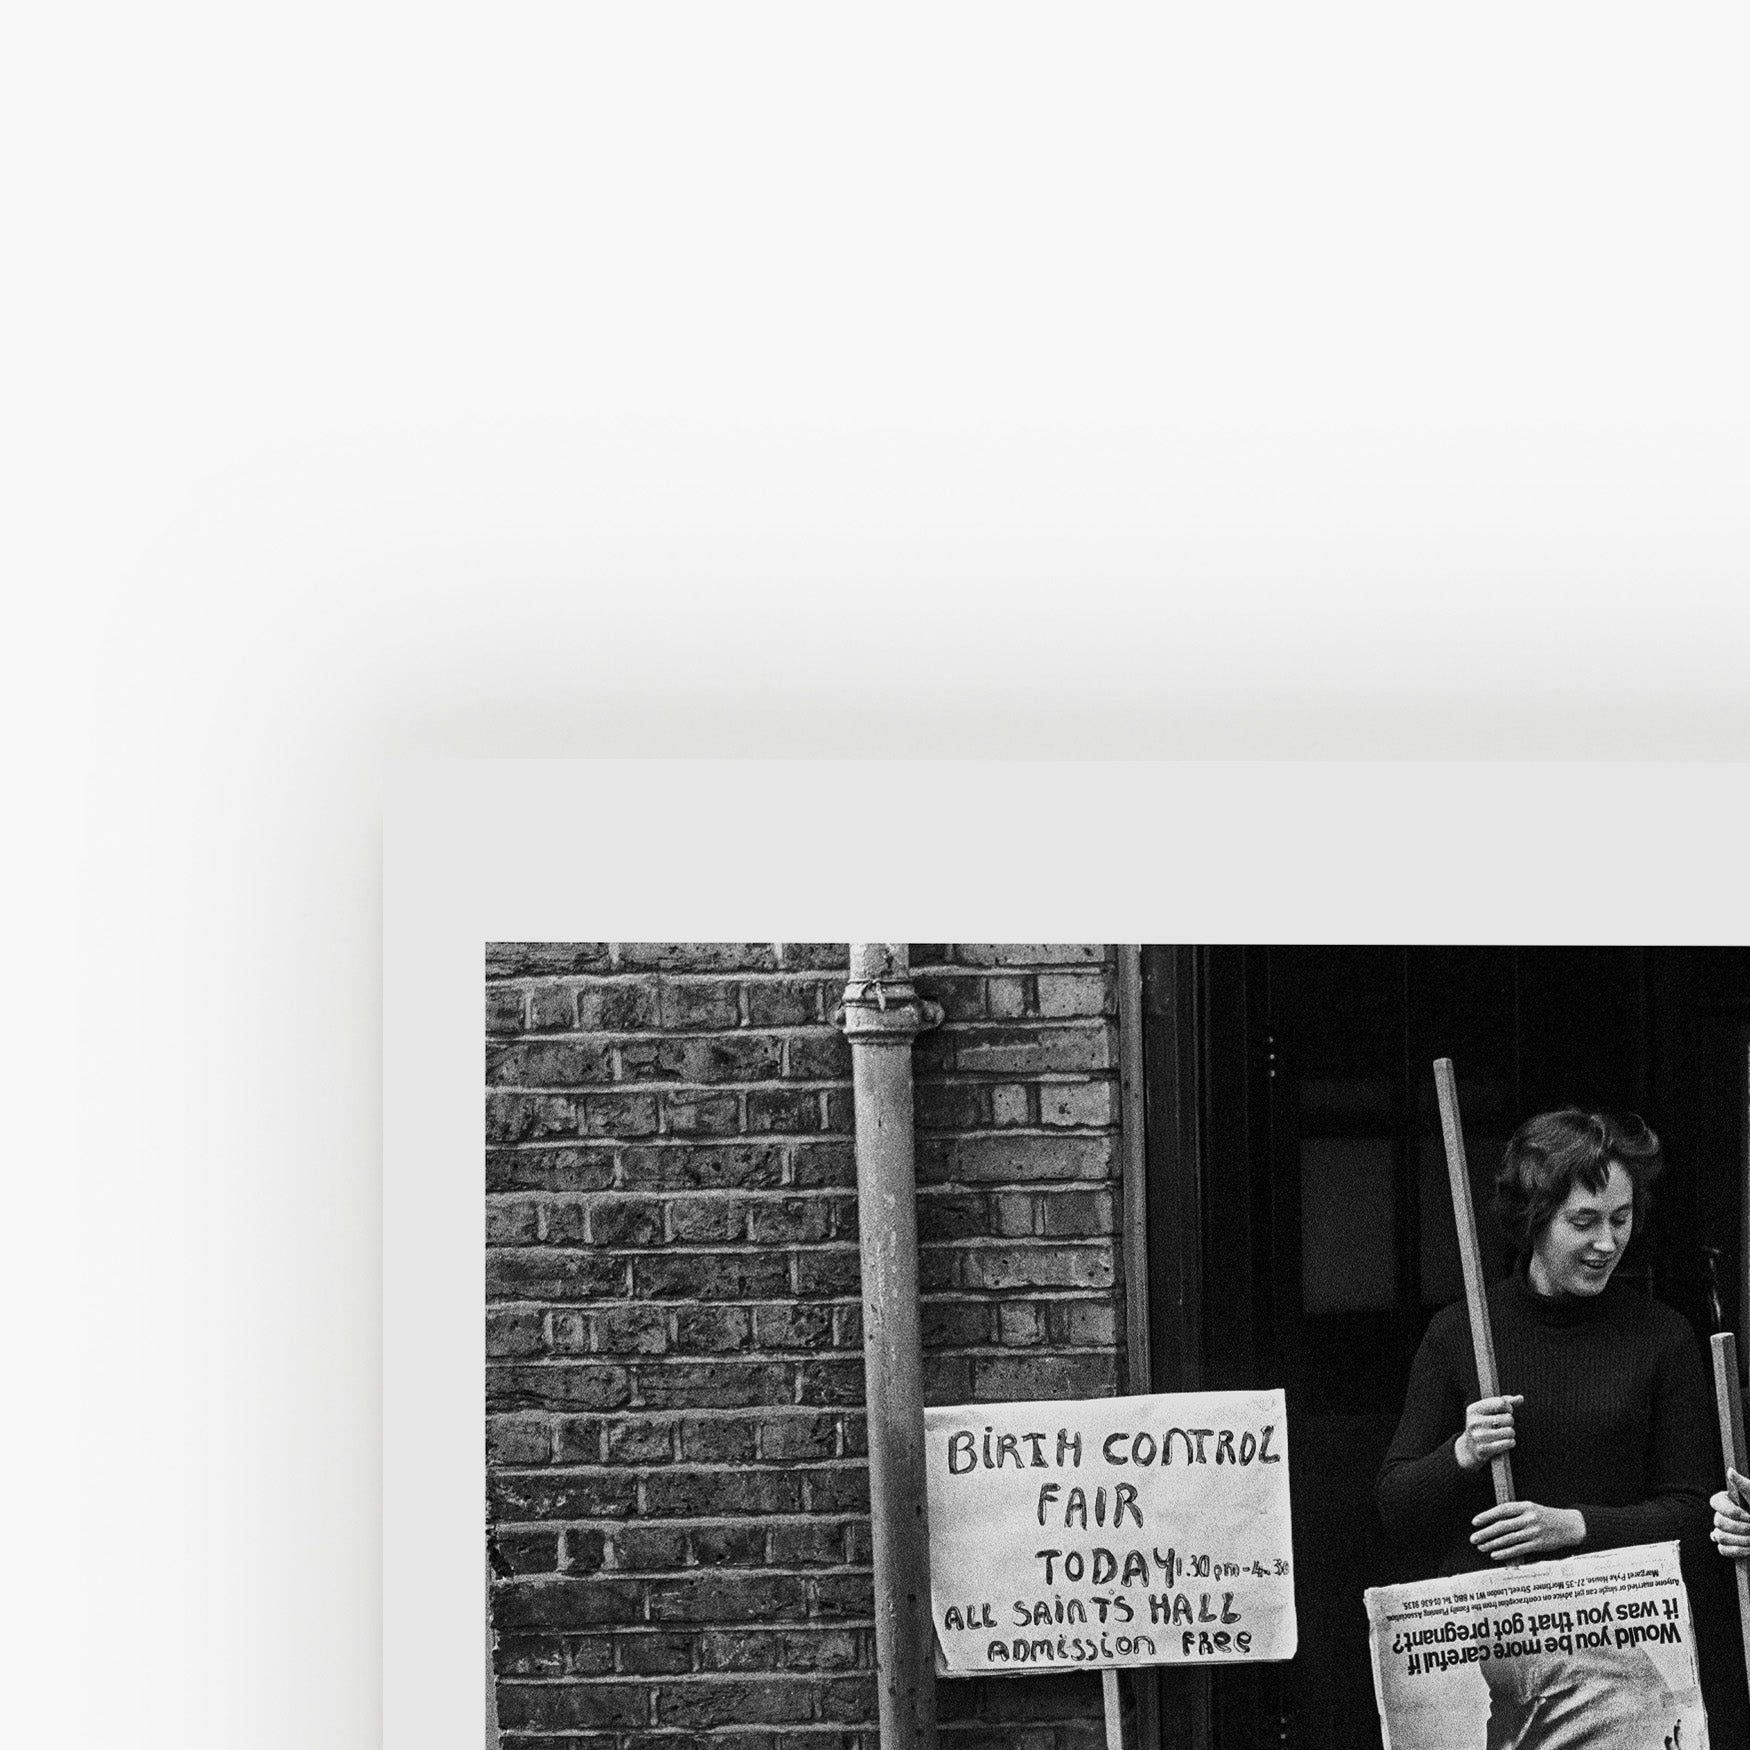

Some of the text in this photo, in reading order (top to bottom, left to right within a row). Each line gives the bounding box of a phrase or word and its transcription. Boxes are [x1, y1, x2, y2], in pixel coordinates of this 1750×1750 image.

[1037, 1482, 1144, 1531] FAIR
[1035, 1547, 1176, 1589] TODAY
[1609, 1572, 1626, 1582] Pyke
[1628, 1569, 1659, 1579] Margaret
[1532, 1581, 1565, 1591] Mortimer
[1627, 1581, 1654, 1592] married
[1655, 1577, 1680, 1586] Anyone
[1551, 1591, 1574, 1600] advice
[1598, 1586, 1619, 1595] single
[1482, 1601, 1498, 1609] from
[1498, 1594, 1541, 1607] contraception
[944, 1602, 998, 1630] ALL
[1148, 1591, 1242, 1626] HALL
[1450, 1604, 1470, 1613] Family
[1471, 1603, 1482, 1611] the
[1392, 1597, 1679, 1654] it was you that got pregnant?
[1407, 1622, 1682, 1675] Would you be more careful if
